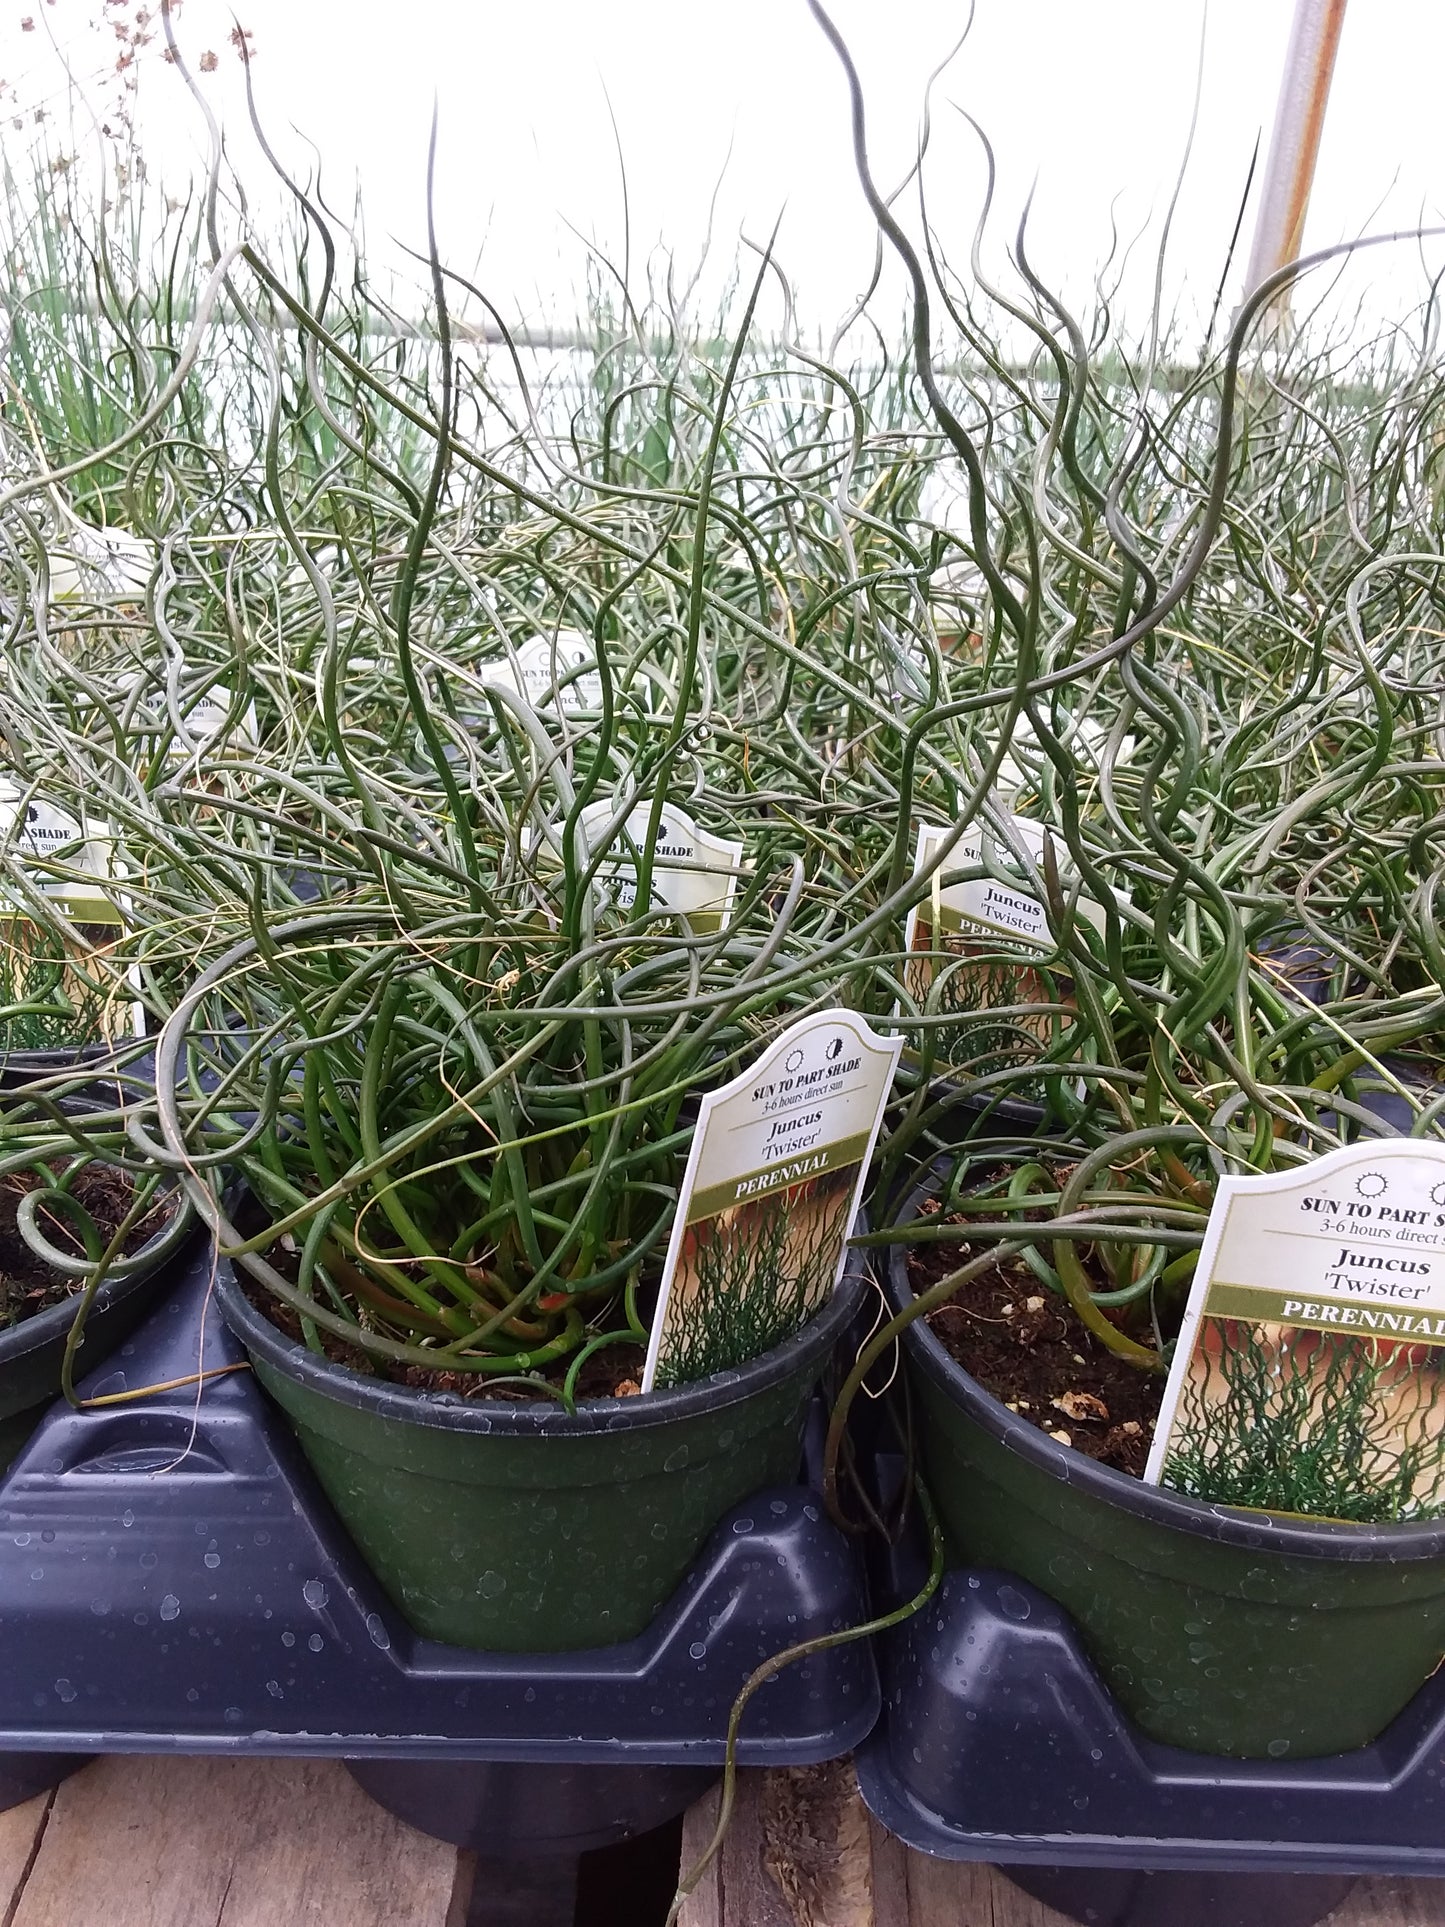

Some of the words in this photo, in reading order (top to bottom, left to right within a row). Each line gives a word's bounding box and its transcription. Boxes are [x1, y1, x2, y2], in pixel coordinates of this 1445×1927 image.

[30, 828, 71, 840] SHADE
[41, 843, 57, 851] sun
[654, 845, 694, 858] SHADE
[984, 888, 1041, 917] Juncus
[981, 903, 1042, 934] 'Twister'
[752, 1083, 777, 1102] SUN
[778, 1078, 794, 1094] TO
[795, 1069, 825, 1088] PART
[826, 1057, 861, 1079] SHADE
[762, 1098, 777, 1115] 3-6
[779, 1092, 803, 1108] hours
[804, 1084, 829, 1099] direct
[829, 1080, 844, 1091] sun
[767, 1110, 822, 1142] Juncus
[762, 1128, 822, 1160] 'Twister'
[734, 1152, 829, 1200] PERENNIAL
[1300, 1197, 1341, 1215] SUN
[1346, 1202, 1372, 1218] TO
[1377, 1206, 1430, 1226] PART
[1319, 1218, 1347, 1233] 3-6
[1348, 1221, 1392, 1239] hours
[1395, 1227, 1439, 1245] direct
[1331, 1248, 1432, 1275] Juncus
[1324, 1272, 1431, 1300] 'Twister'
